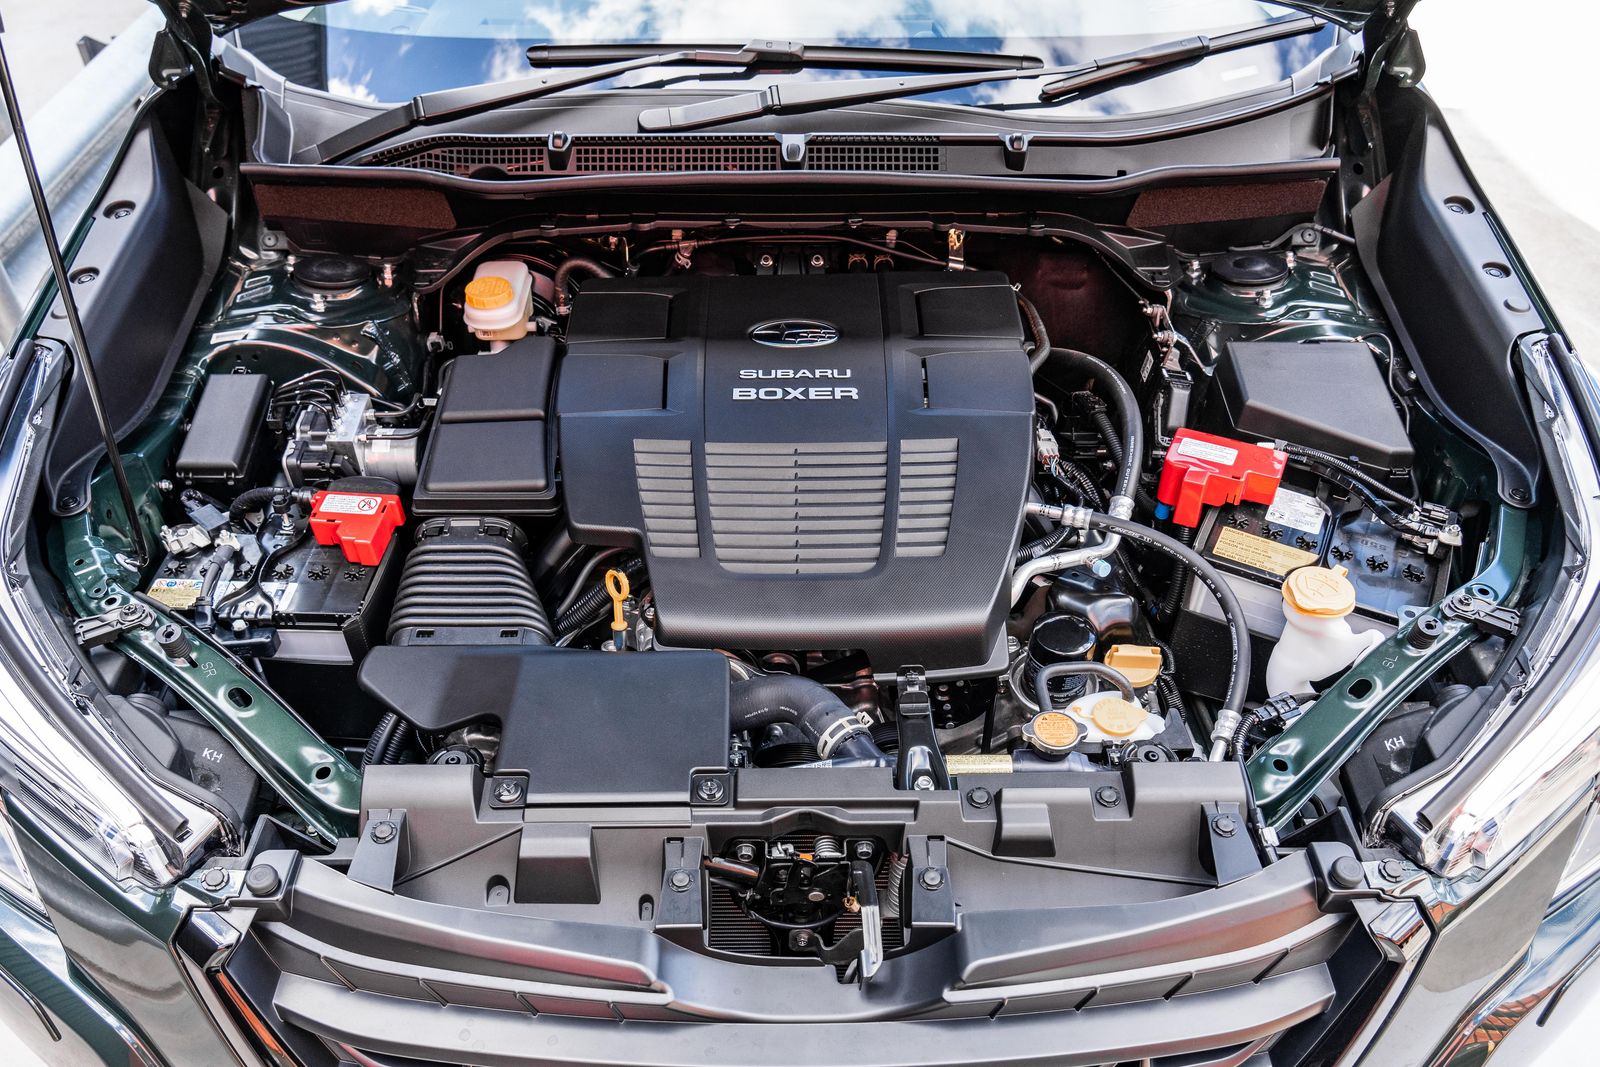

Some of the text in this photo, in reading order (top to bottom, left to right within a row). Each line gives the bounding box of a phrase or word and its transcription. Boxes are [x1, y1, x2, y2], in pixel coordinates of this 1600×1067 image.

[738, 368, 852, 380] SUBARU
[731, 386, 860, 401] BOXER
[201, 661, 217, 678] SR
[1382, 655, 1399, 669] SL
[1384, 735, 1406, 751] KH
[202, 747, 223, 763] KH
